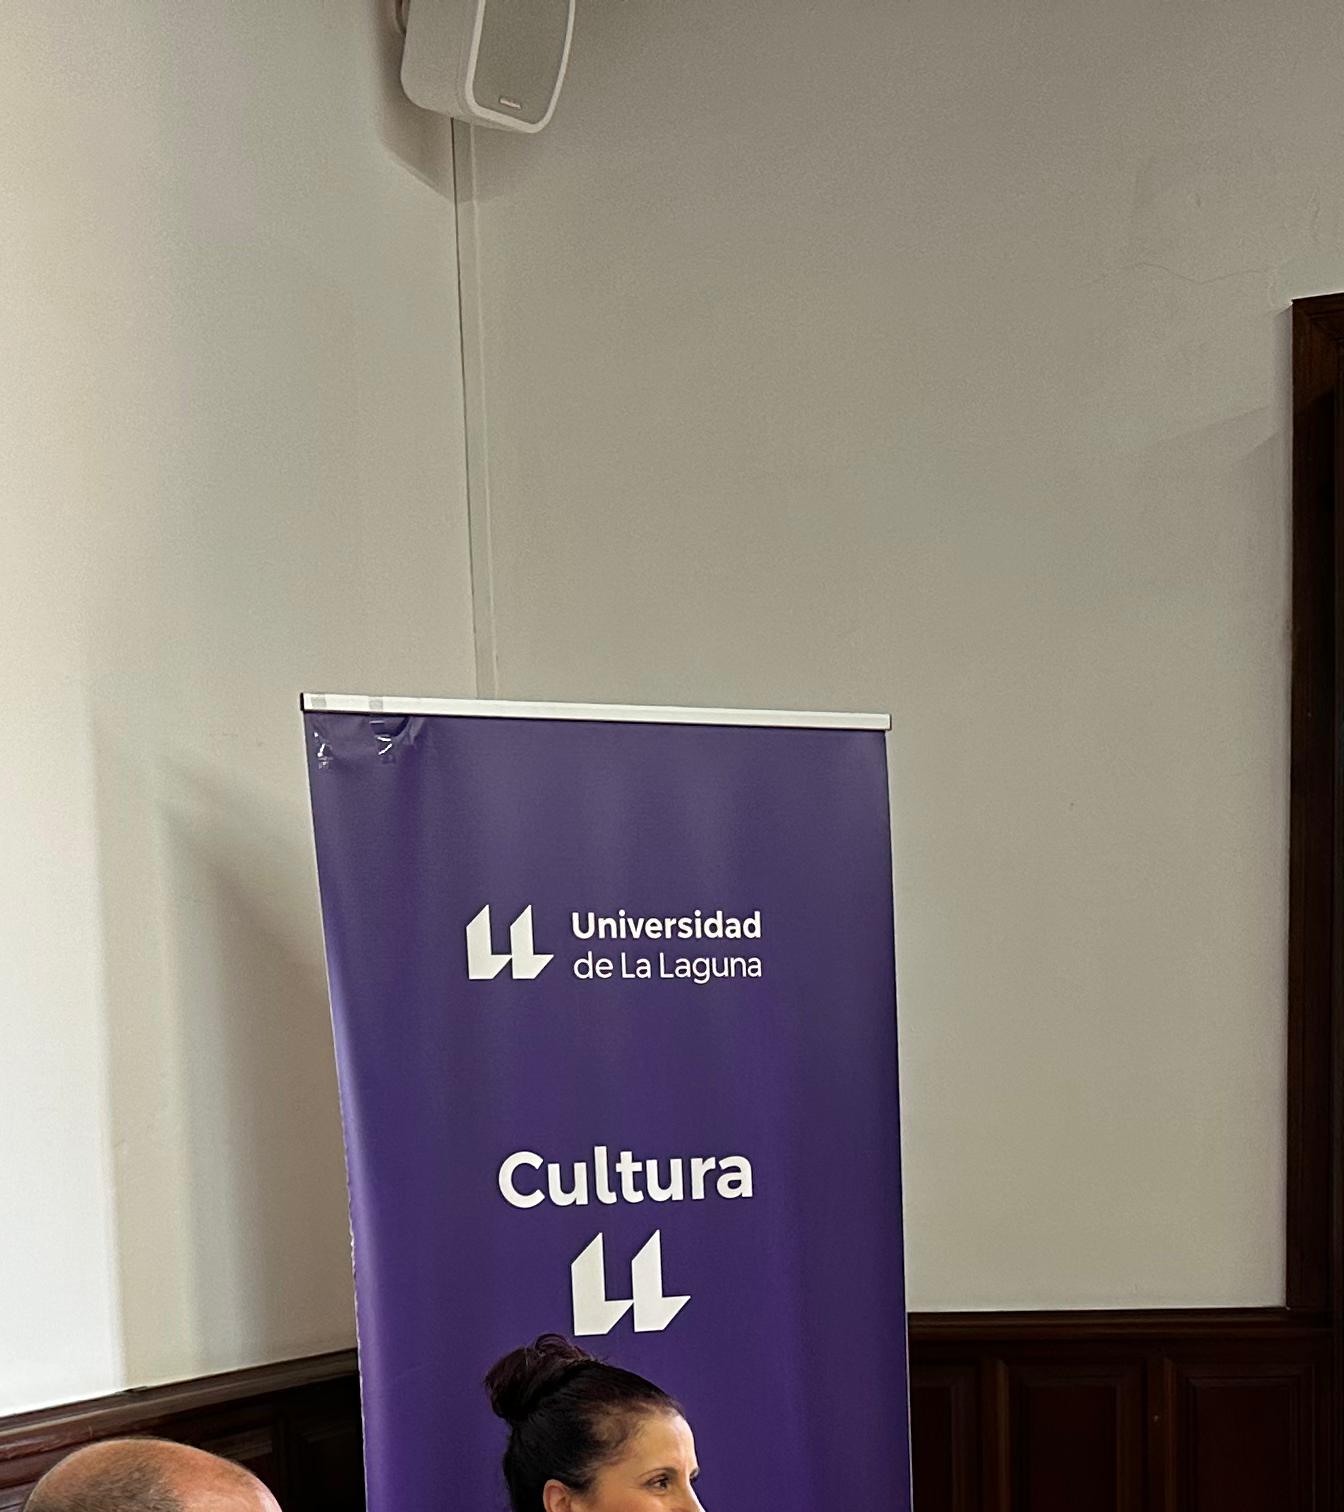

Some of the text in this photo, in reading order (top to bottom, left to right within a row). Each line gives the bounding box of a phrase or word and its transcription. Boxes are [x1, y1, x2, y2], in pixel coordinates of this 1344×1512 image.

[572, 909, 762, 940] Universidad
[572, 950, 762, 984] de La Laguna
[498, 1145, 753, 1209] Cultura
